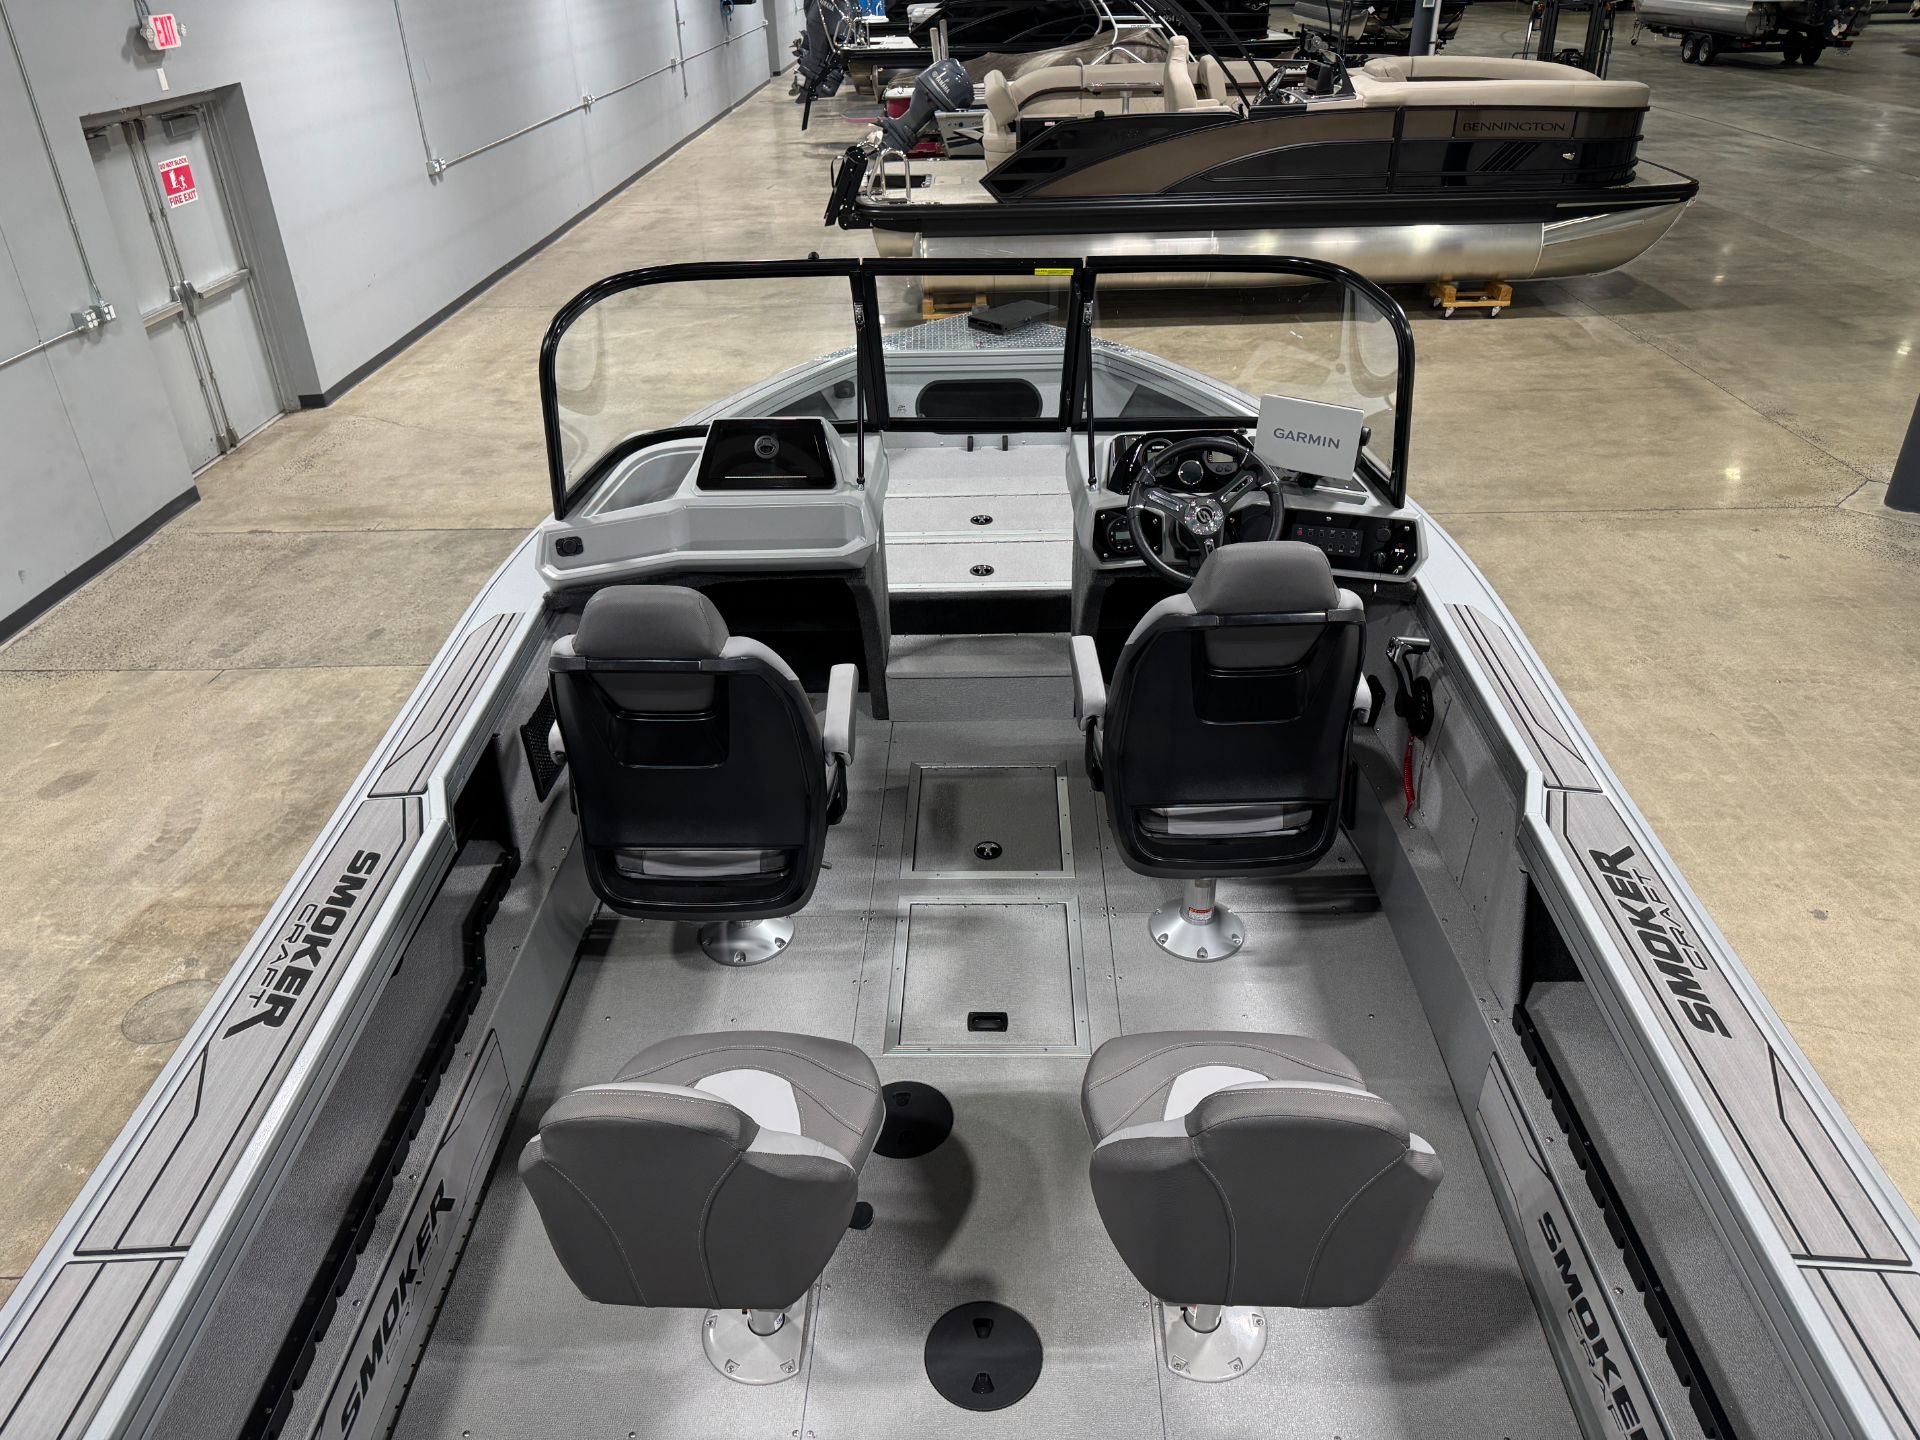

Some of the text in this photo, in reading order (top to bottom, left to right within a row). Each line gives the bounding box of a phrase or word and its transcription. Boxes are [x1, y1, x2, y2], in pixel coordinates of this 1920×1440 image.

[153, 16, 177, 47] EXIT
[936, 71, 950, 94] YAMAHA
[1463, 122, 1566, 132] BENNINGTON
[169, 190, 197, 206] FIRE EXIT
[1273, 427, 1341, 450] GARMIN
[222, 849, 381, 1040] SMOKER
[249, 903, 319, 1009] CRAFT
[1588, 845, 1733, 1039] SMOKER
[1632, 868, 1708, 971] CRAFT
[341, 1178, 456, 1440] SMOKER
[1567, 1308, 1628, 1440] CRAF
